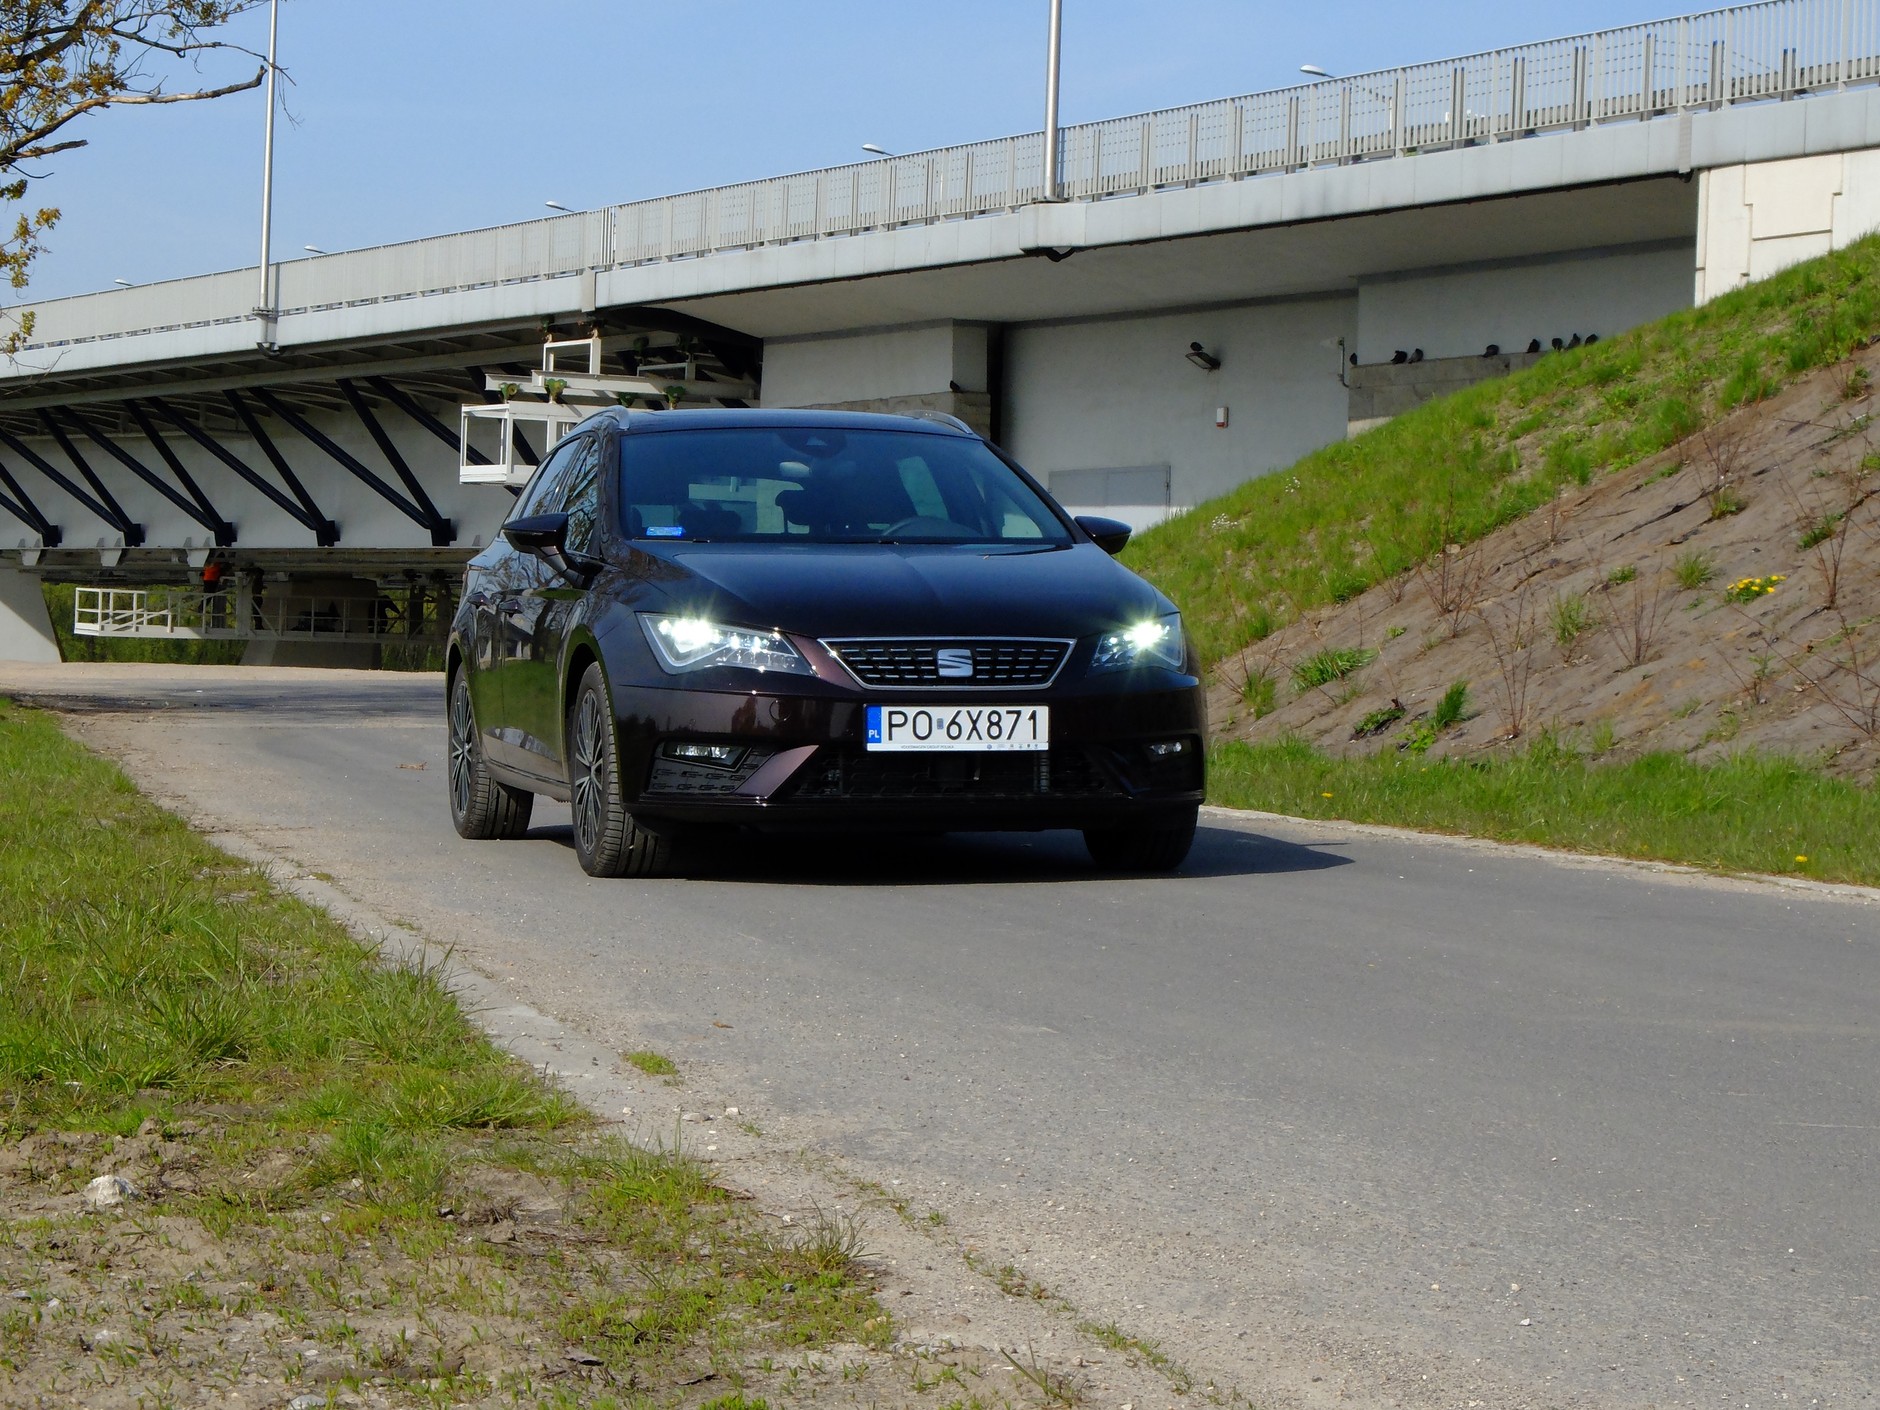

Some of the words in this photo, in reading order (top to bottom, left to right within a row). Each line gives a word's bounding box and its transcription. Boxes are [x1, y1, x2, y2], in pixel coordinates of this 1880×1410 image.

[869, 729, 880, 738] PL
[888, 710, 932, 741] PO
[946, 710, 1037, 740] 6X871
